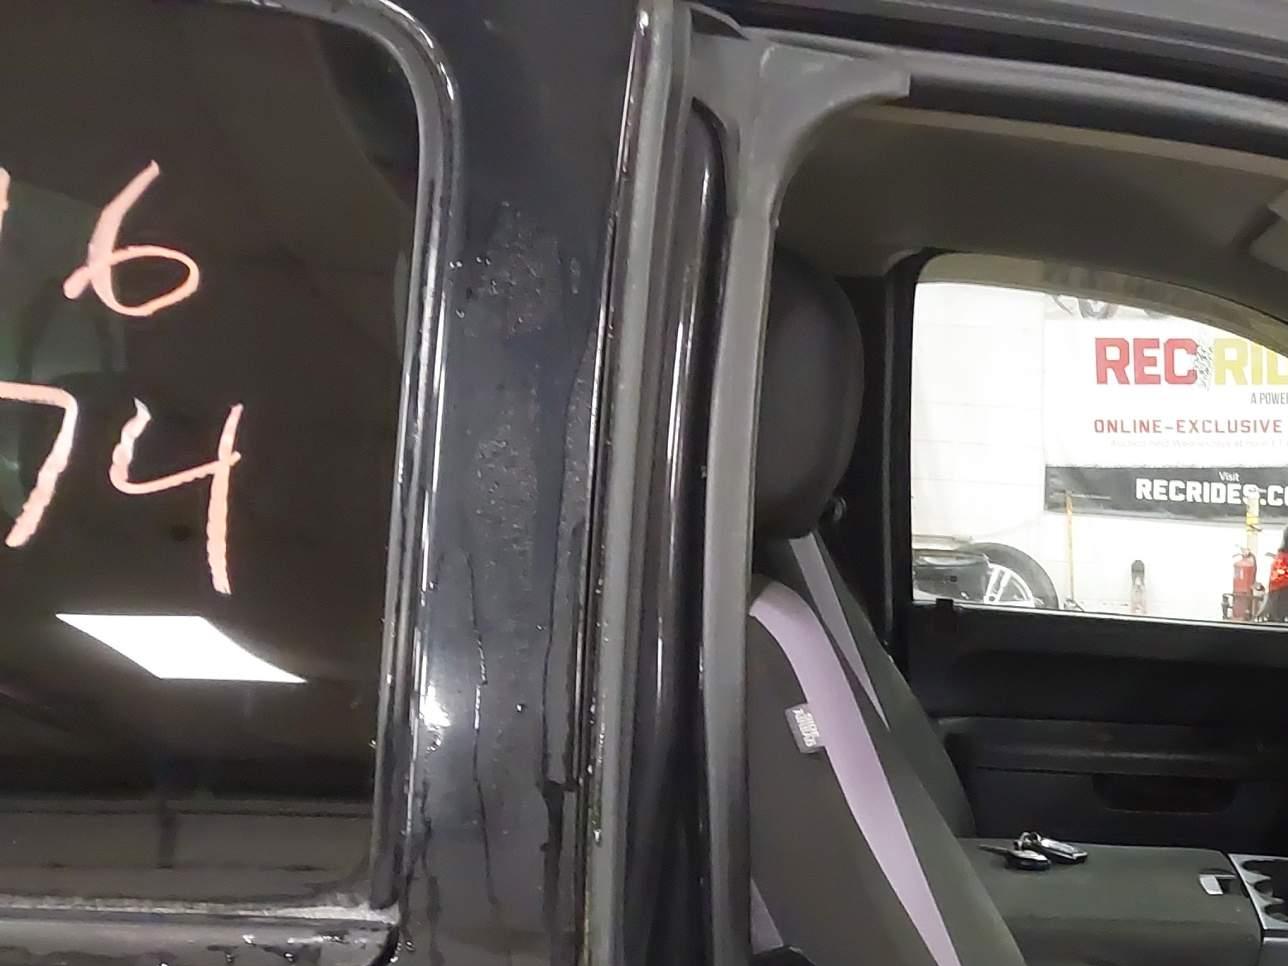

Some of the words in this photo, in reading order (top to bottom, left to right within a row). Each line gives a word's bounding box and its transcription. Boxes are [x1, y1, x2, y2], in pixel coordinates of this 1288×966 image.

[1095, 337, 1198, 385] REC
[1250, 392, 1257, 405] A
[1094, 419, 1282, 434] ONLINE-EXCLUSIVE
[1218, 471, 1240, 482] Visit
